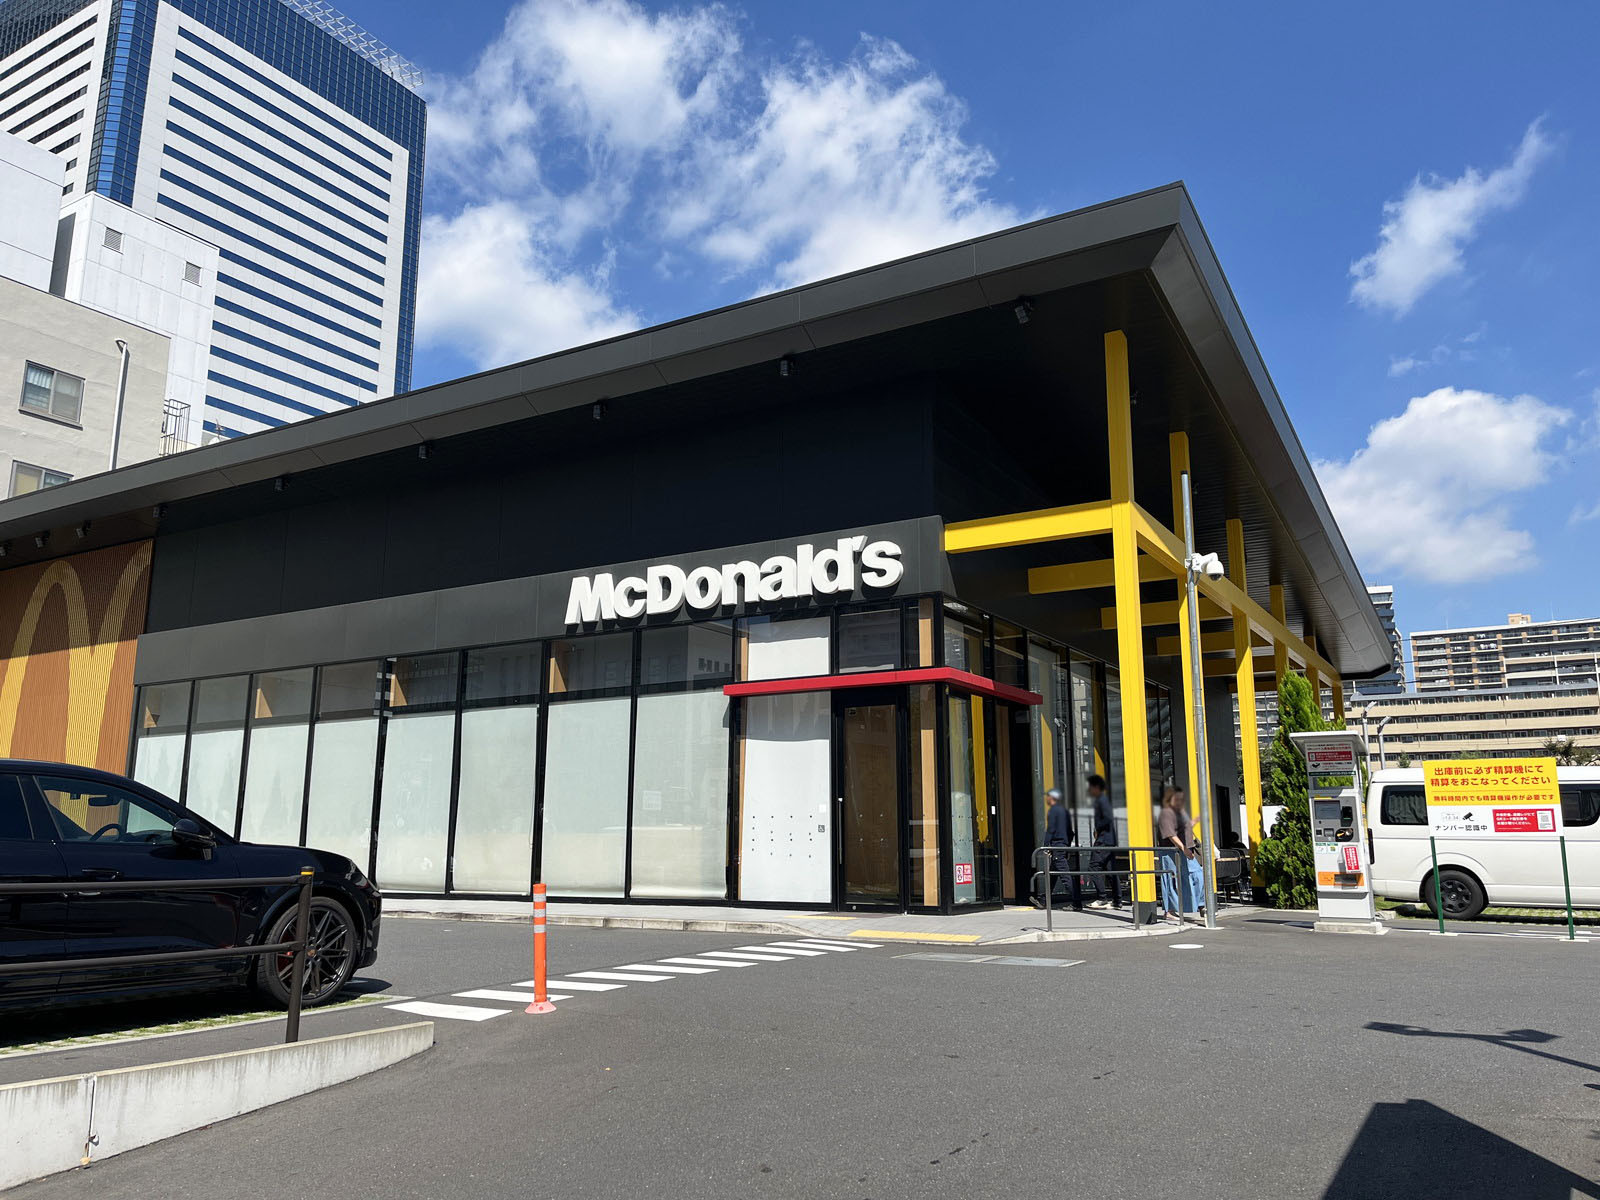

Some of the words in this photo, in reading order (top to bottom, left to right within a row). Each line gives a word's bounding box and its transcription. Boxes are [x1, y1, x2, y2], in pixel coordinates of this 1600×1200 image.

[564, 535, 904, 625] McDonald's
[1434, 765, 1544, 775] 出庫前に必ず精算機にて
[1431, 776, 1551, 786] 精算をおこなってください
